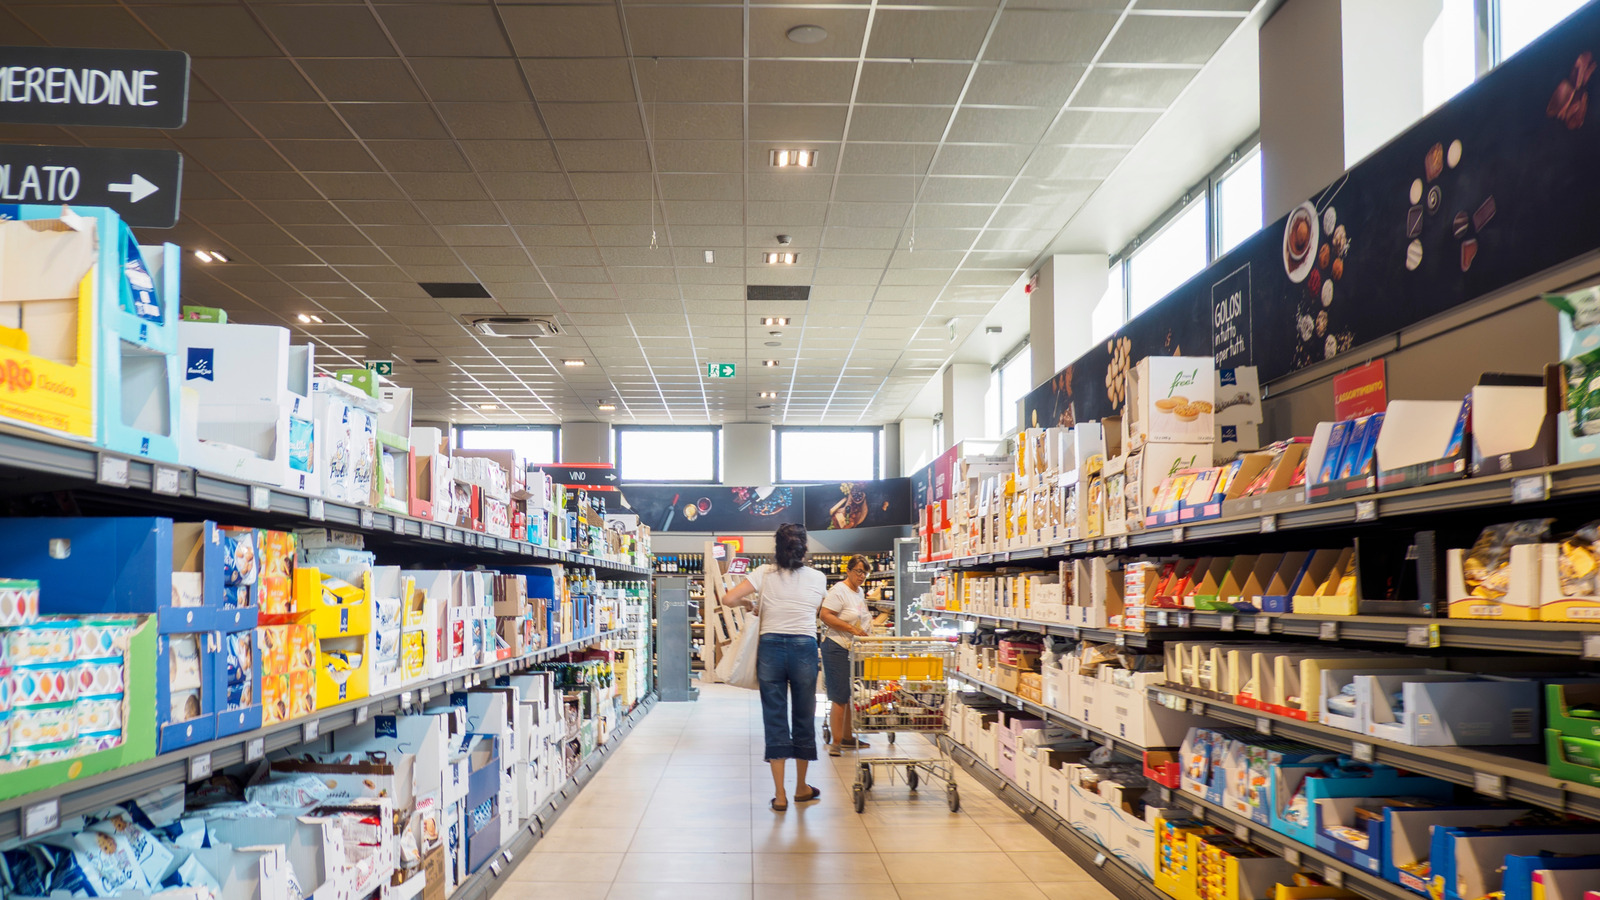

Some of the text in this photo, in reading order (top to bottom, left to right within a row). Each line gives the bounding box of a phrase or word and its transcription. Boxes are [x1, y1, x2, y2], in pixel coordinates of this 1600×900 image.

[1214, 290, 1242, 328] GOLOSI
[1221, 321, 1237, 342] tutto
[569, 471, 587, 481] VINO
